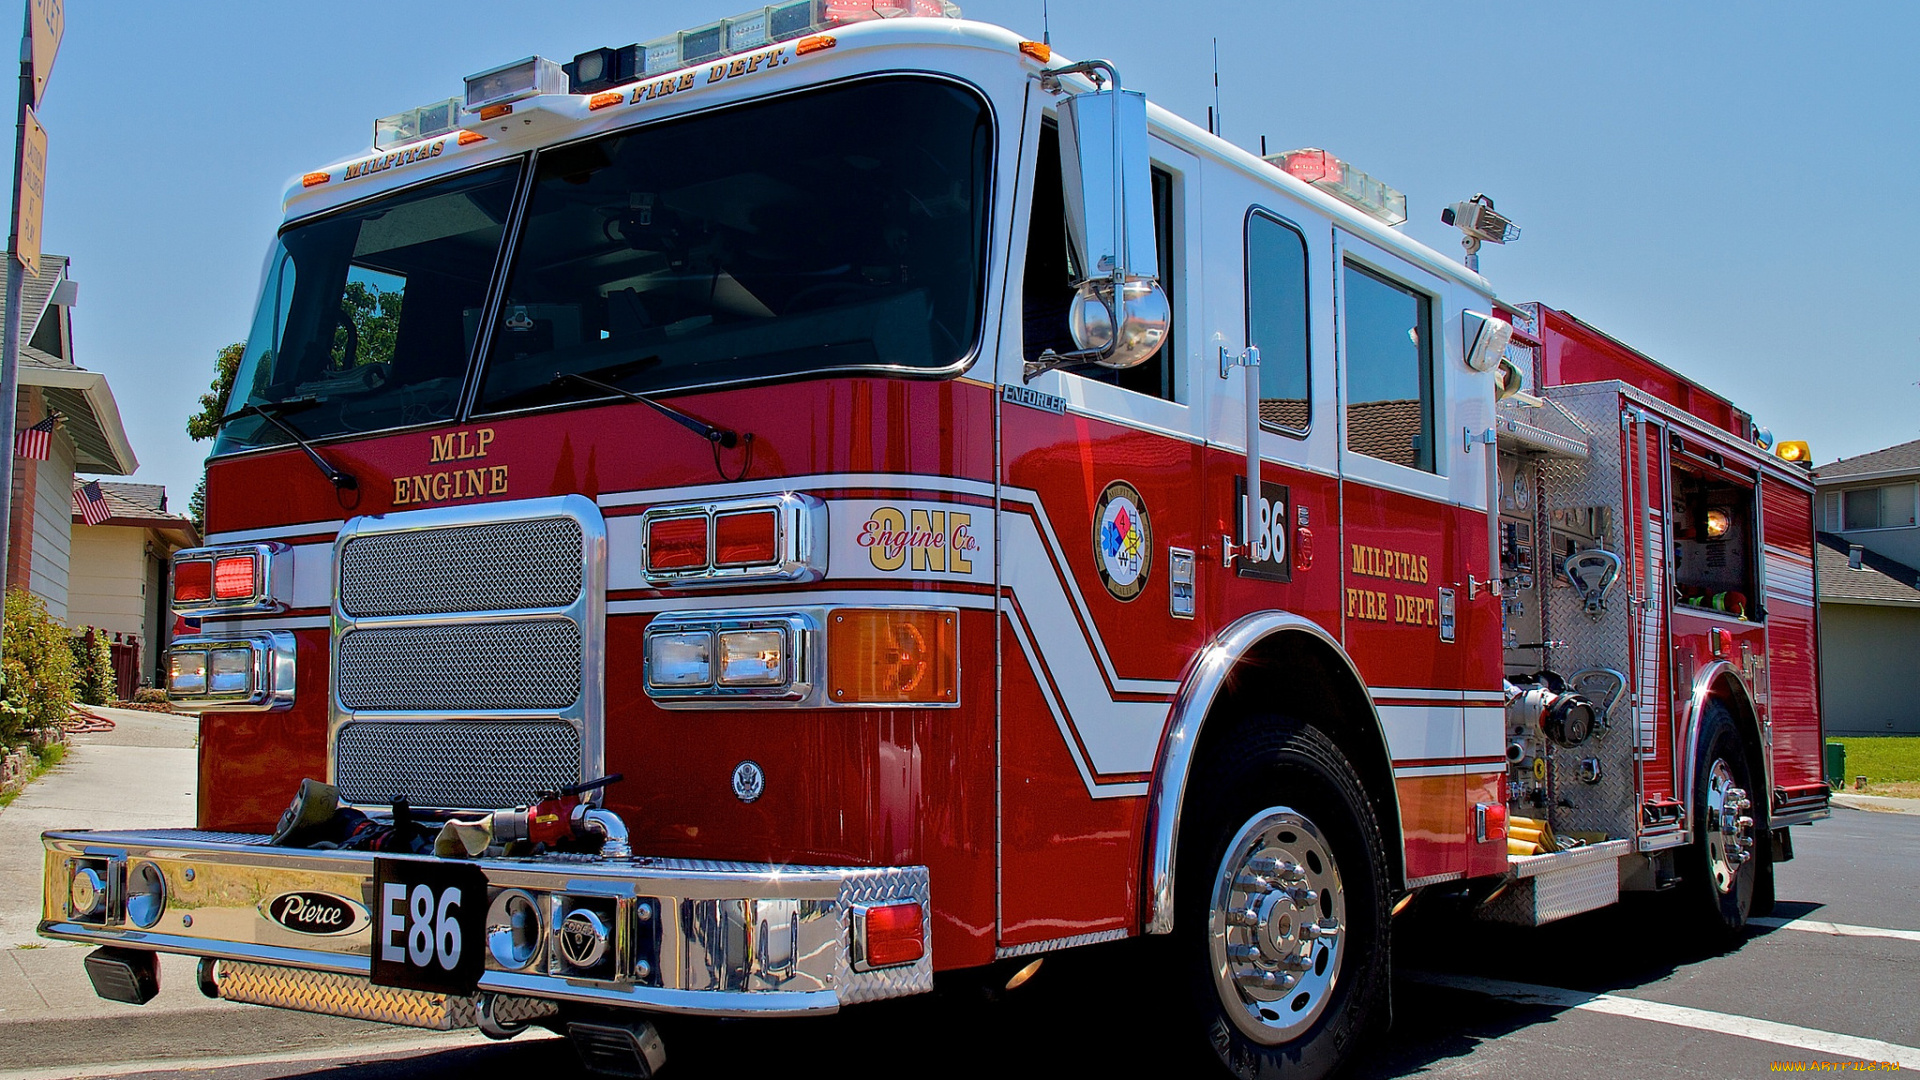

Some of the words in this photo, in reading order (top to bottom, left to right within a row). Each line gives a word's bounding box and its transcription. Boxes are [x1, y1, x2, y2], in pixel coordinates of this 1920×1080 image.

[629, 70, 698, 105] FIRE
[707, 46, 790, 84] DEPT.
[27, 137, 43, 174] CAUTION
[343, 139, 447, 181] MILPITAS
[23, 161, 42, 199] CHILDREN
[25, 218, 36, 245] PLAY
[1003, 384, 1066, 412] ENFORCER
[429, 427, 495, 464] MLP
[392, 465, 508, 506] ENGINE
[856, 520, 945, 558] Engine
[952, 524, 980, 552] Co.
[869, 506, 972, 575] ONE
[1351, 544, 1429, 585] MILPITAS
[1346, 588, 1388, 622] FIRE
[1394, 594, 1438, 627] DEPT.
[281, 894, 343, 925] Pierce
[381, 882, 462, 971] E86
